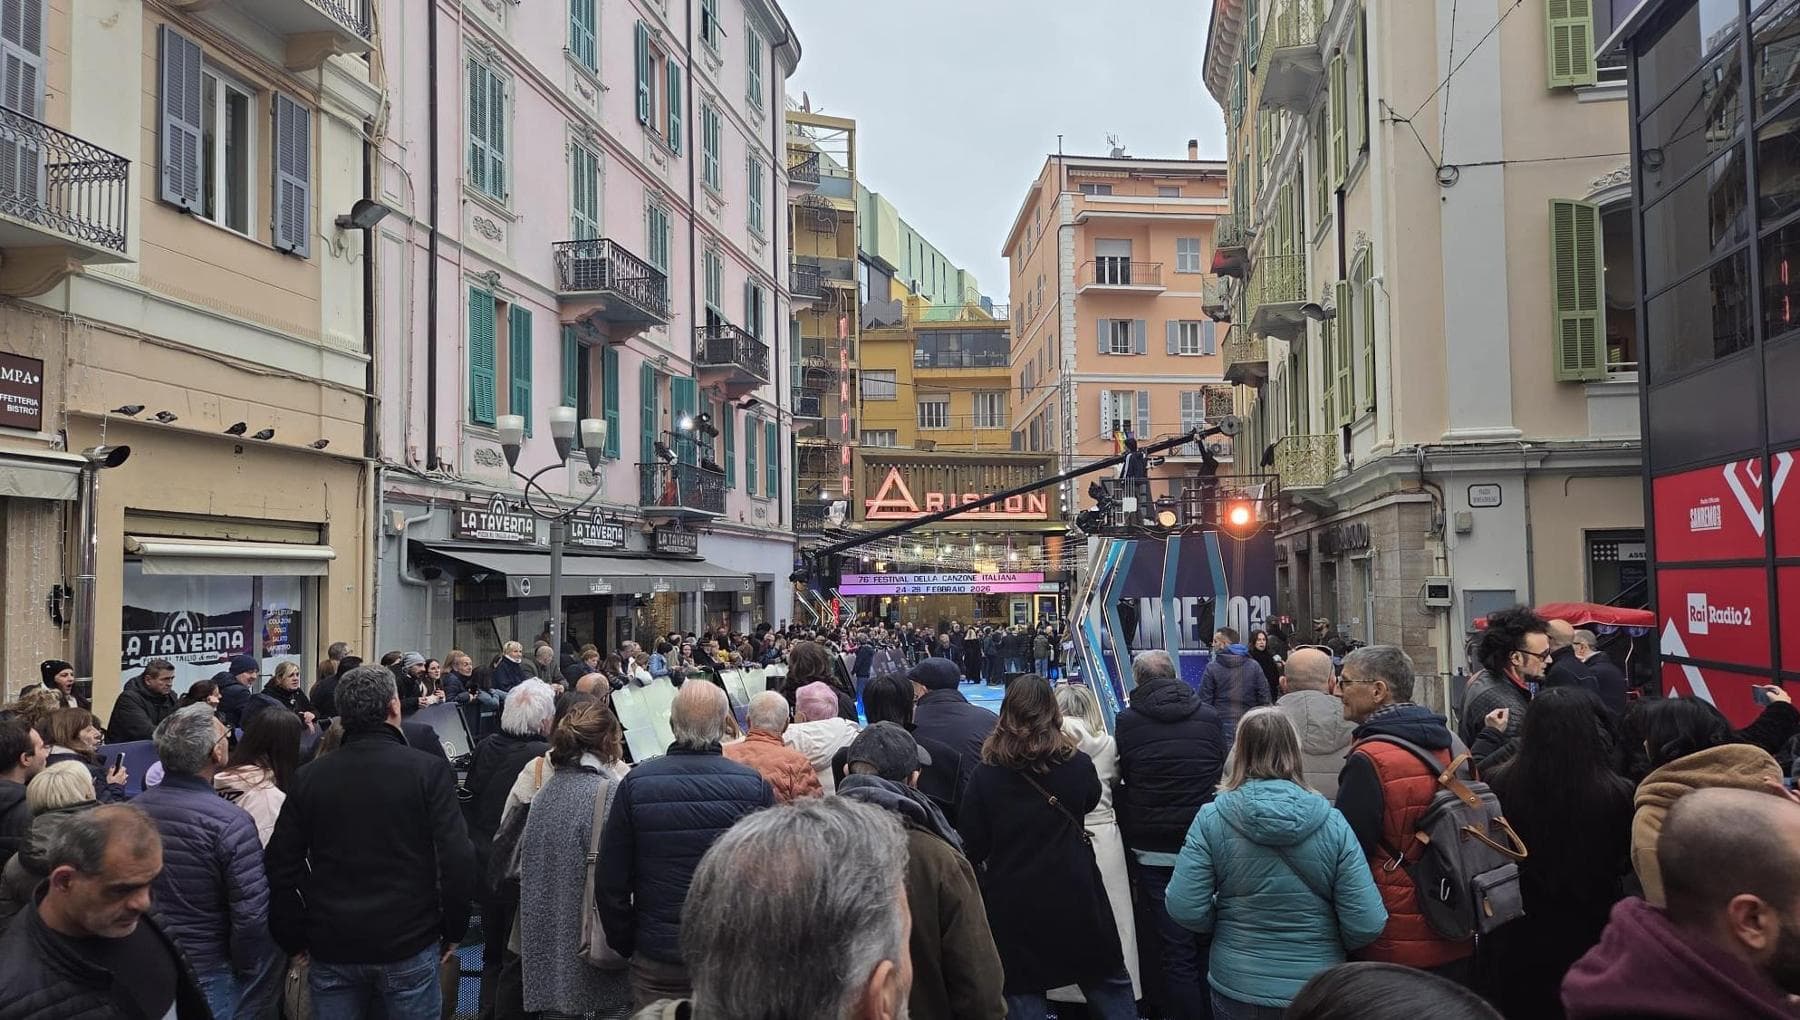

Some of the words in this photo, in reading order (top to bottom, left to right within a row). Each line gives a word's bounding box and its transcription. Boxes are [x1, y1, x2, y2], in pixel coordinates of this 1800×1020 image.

[7, 404, 39, 416] BISTROT
[461, 511, 477, 529] LA
[480, 514, 533, 534] TAVERNA
[571, 522, 583, 538] LA
[585, 524, 623, 541] TAVERNA
[658, 532, 668, 545] LA
[668, 533, 697, 547] TAVERNA
[873, 575, 908, 583] FESTIVAL
[913, 575, 938, 583] DELLA
[942, 574, 978, 582] CANZONE
[926, 585, 966, 593] FEBBRAIO
[1690, 605, 1706, 622] Rai
[1708, 605, 1743, 625] Radio
[1743, 606, 1752, 626] 2
[120, 636, 141, 657] A
[149, 630, 244, 655] TAVERNA
